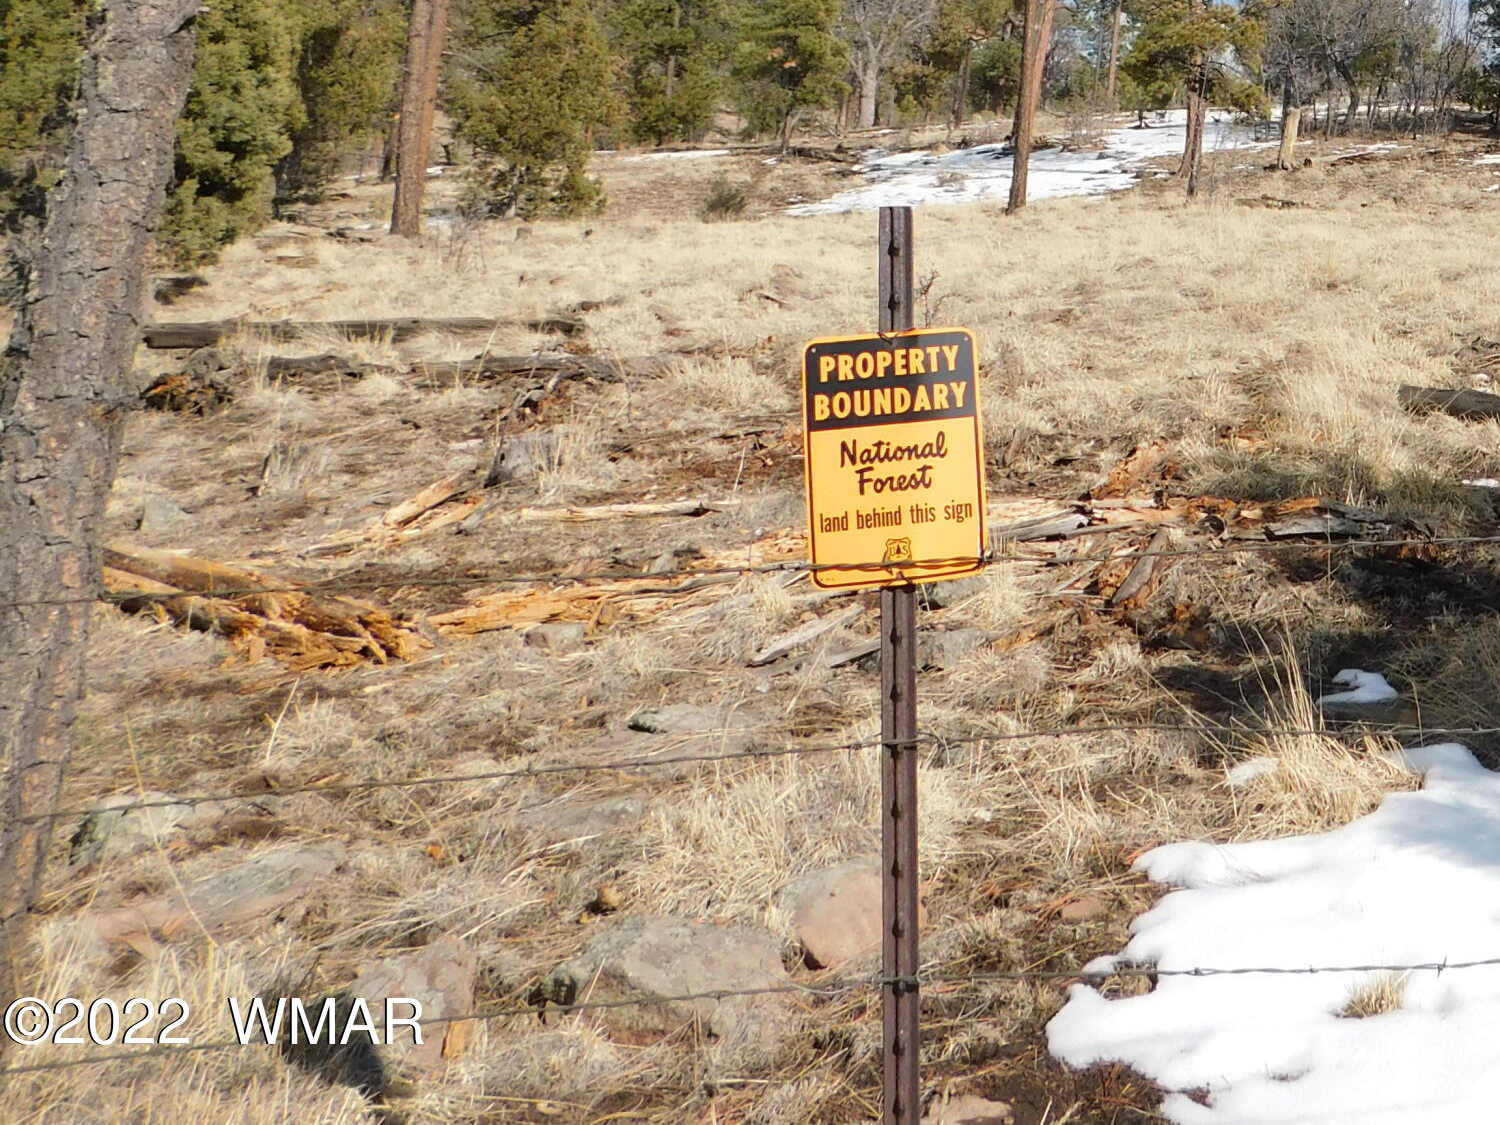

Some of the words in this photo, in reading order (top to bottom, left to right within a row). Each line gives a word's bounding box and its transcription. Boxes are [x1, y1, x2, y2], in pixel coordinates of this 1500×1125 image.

[819, 345, 959, 382] PROPERTY
[814, 382, 967, 421] BOUNDARY
[840, 431, 948, 467] National
[855, 465, 933, 495] Forest
[820, 511, 849, 533] land
[856, 506, 902, 529] behind
[910, 503, 936, 523] this
[944, 500, 973, 522] sign
